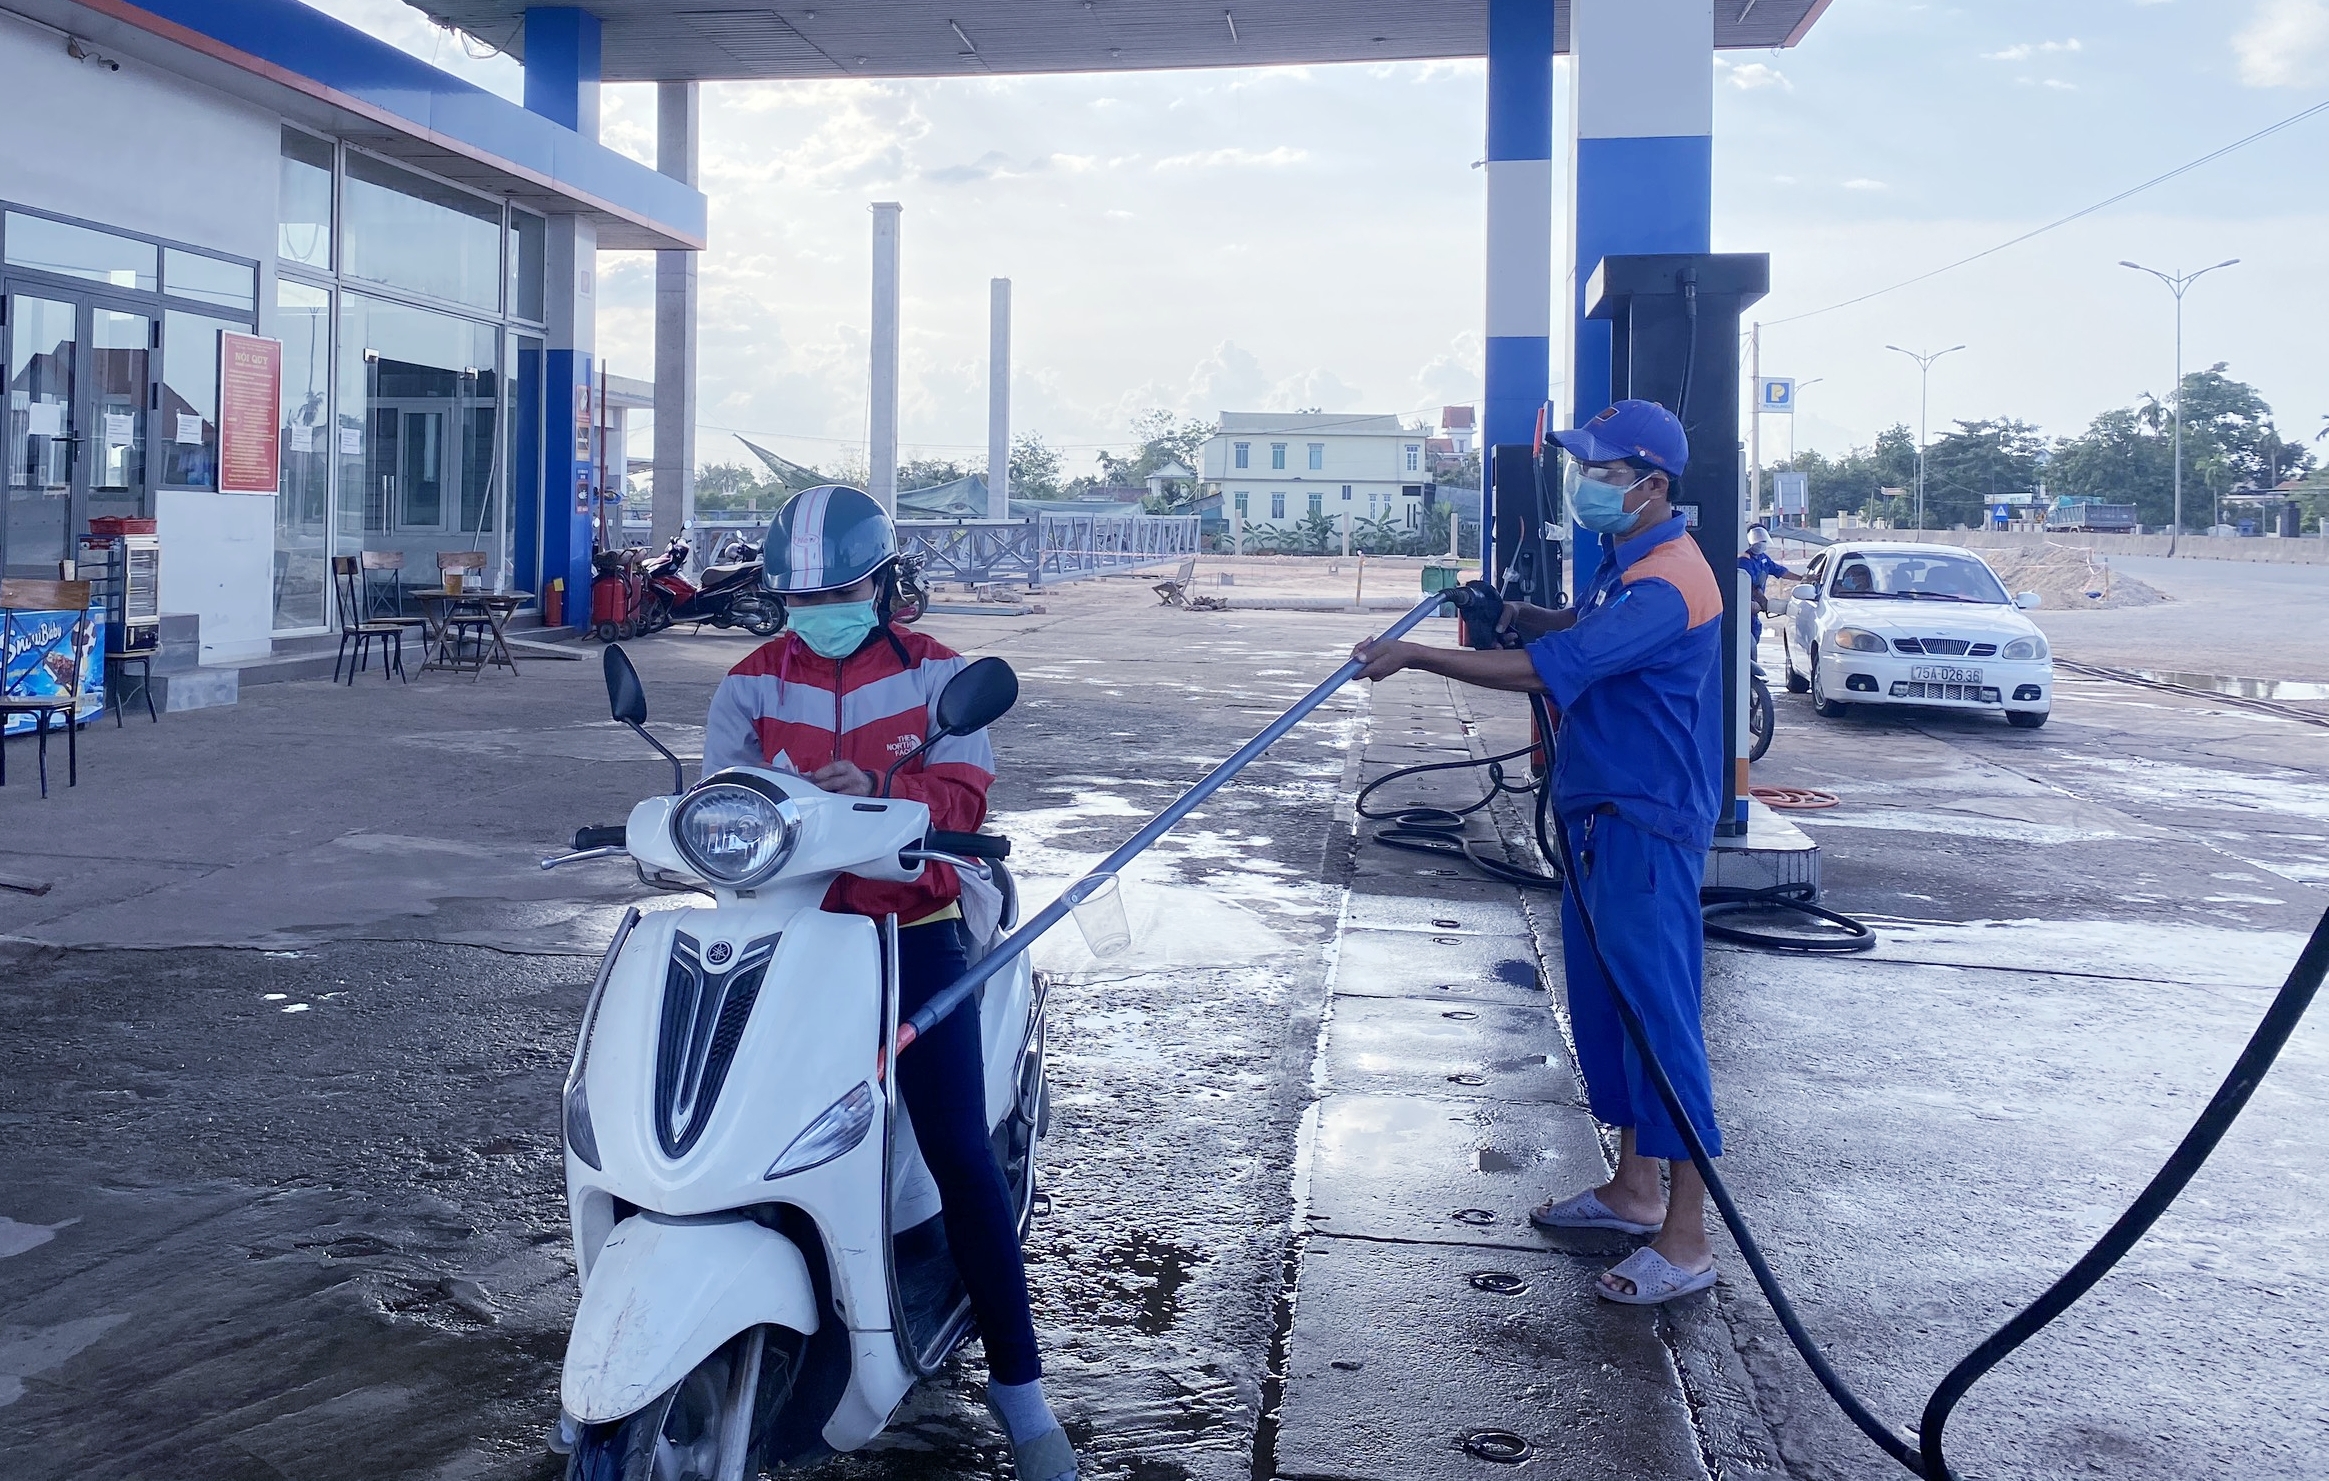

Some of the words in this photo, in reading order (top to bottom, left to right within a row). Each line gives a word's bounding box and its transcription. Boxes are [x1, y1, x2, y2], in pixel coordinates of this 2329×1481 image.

[897, 735, 911, 743] THE
[886, 741, 912, 751] NORTH
[894, 749, 911, 757] FAC
